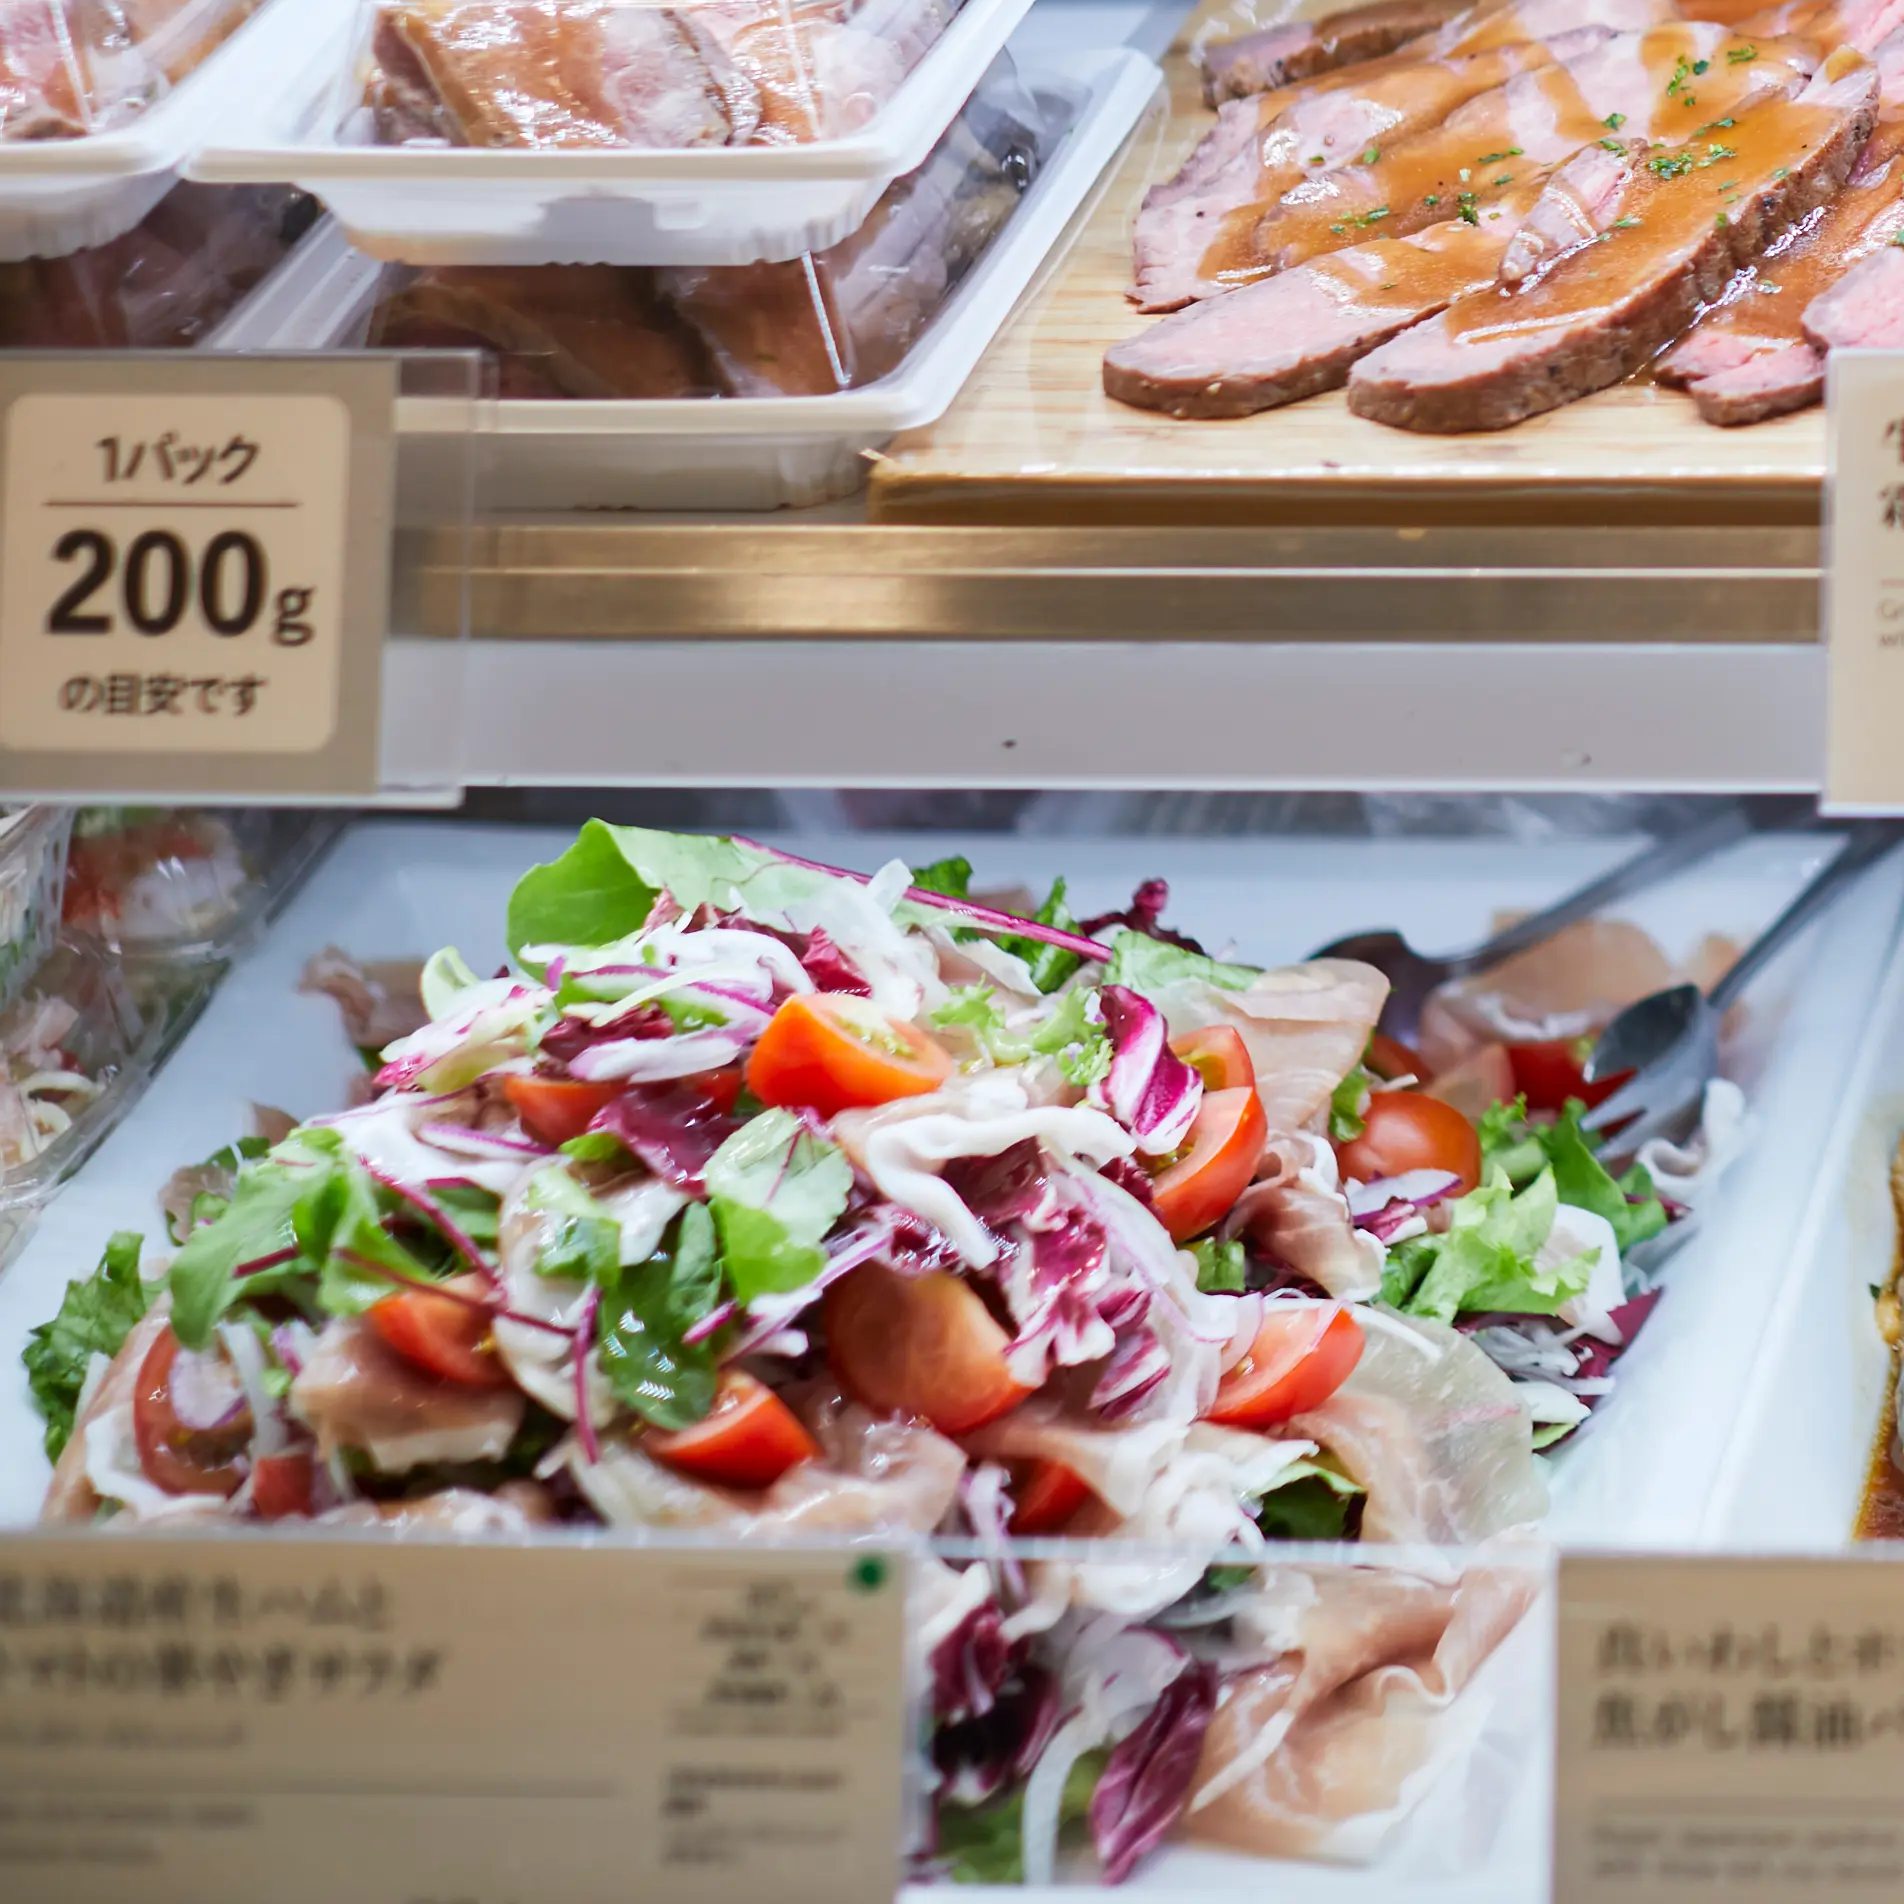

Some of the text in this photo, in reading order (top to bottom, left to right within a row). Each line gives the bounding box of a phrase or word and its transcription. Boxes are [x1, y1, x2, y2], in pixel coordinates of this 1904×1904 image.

[45, 527, 314, 648] 200g
[60, 672, 266, 716] の目安です
